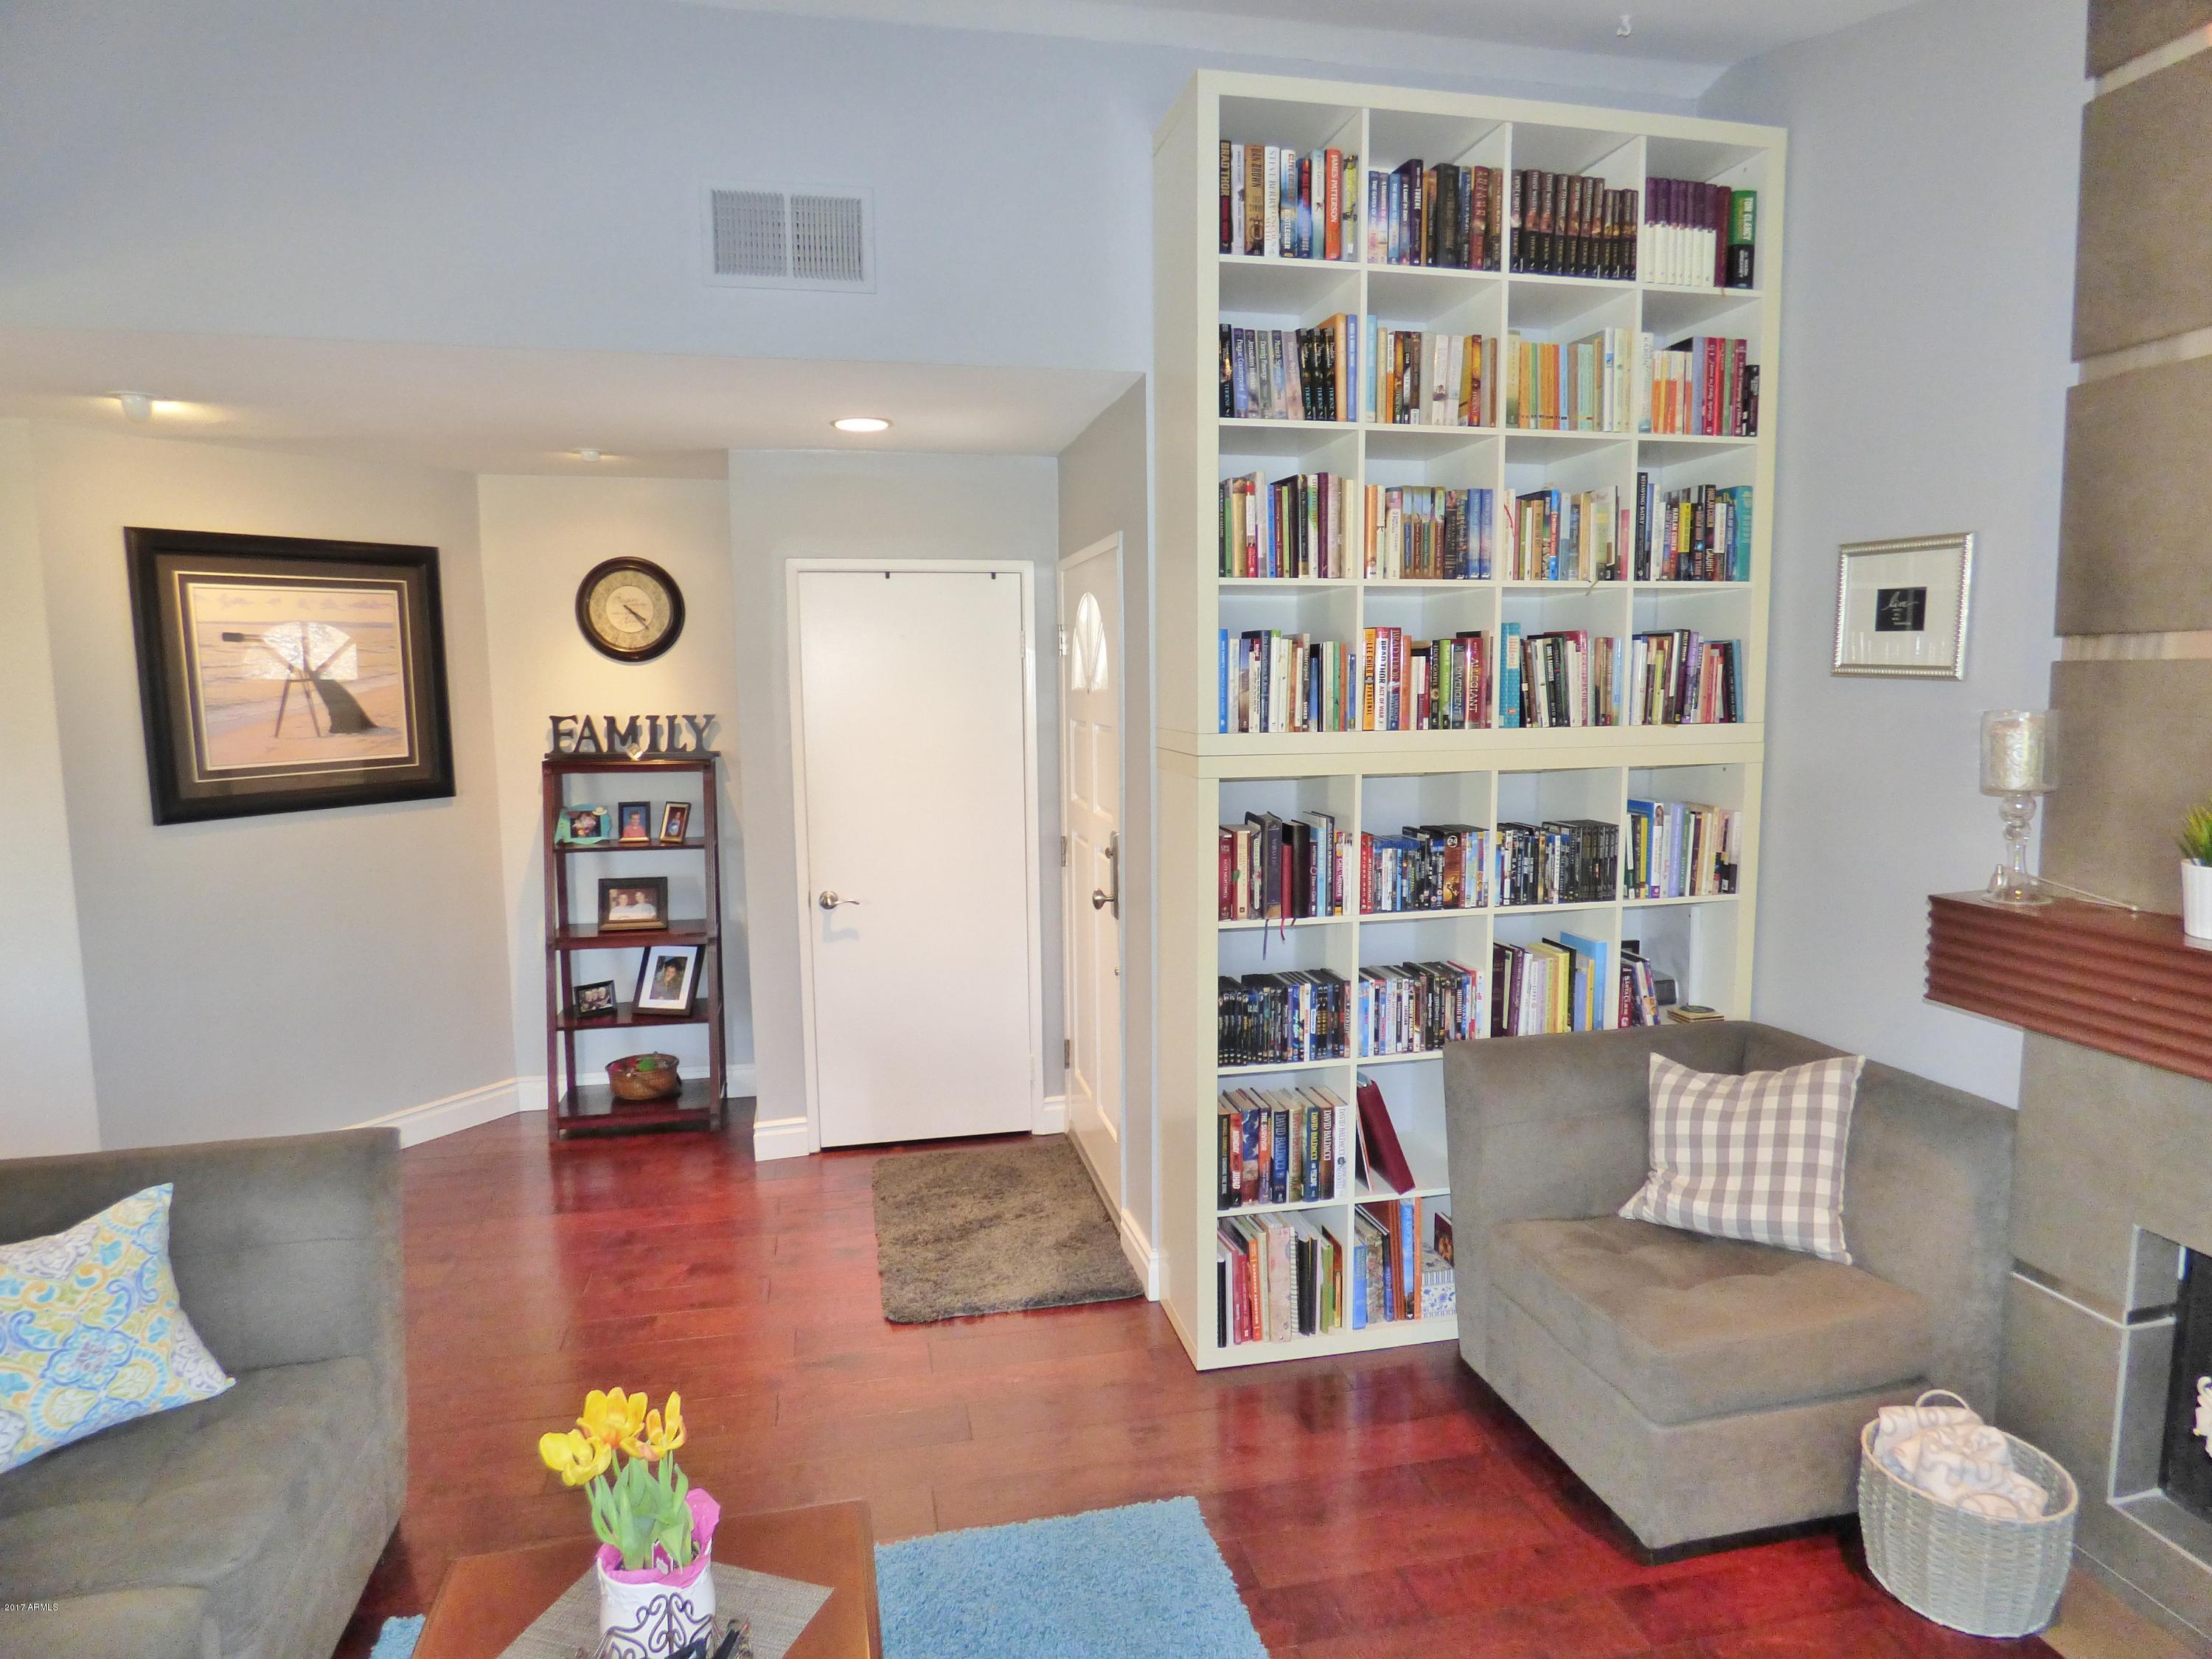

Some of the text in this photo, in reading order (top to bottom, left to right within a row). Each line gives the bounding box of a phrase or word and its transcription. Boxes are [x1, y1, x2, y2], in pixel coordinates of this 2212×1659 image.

[1220, 142, 1230, 170] BRAD
[1251, 148, 1263, 187] DAN BROWN
[1220, 171, 1230, 196] THOR
[1742, 198, 1753, 240] TOM CLANCY
[1236, 339, 1245, 391] Prague Counterpoint
[1705, 549, 1714, 572] CAUGHT
[1470, 658, 1479, 713] ALLEGIANT
[549, 714, 717, 753] FAMILY
[1276, 1114, 1286, 1170] DAVID BALDACCI
[1324, 1110, 1332, 1161] DAVID BALDACCI
[1233, 1171, 1241, 1189] JIHAD
